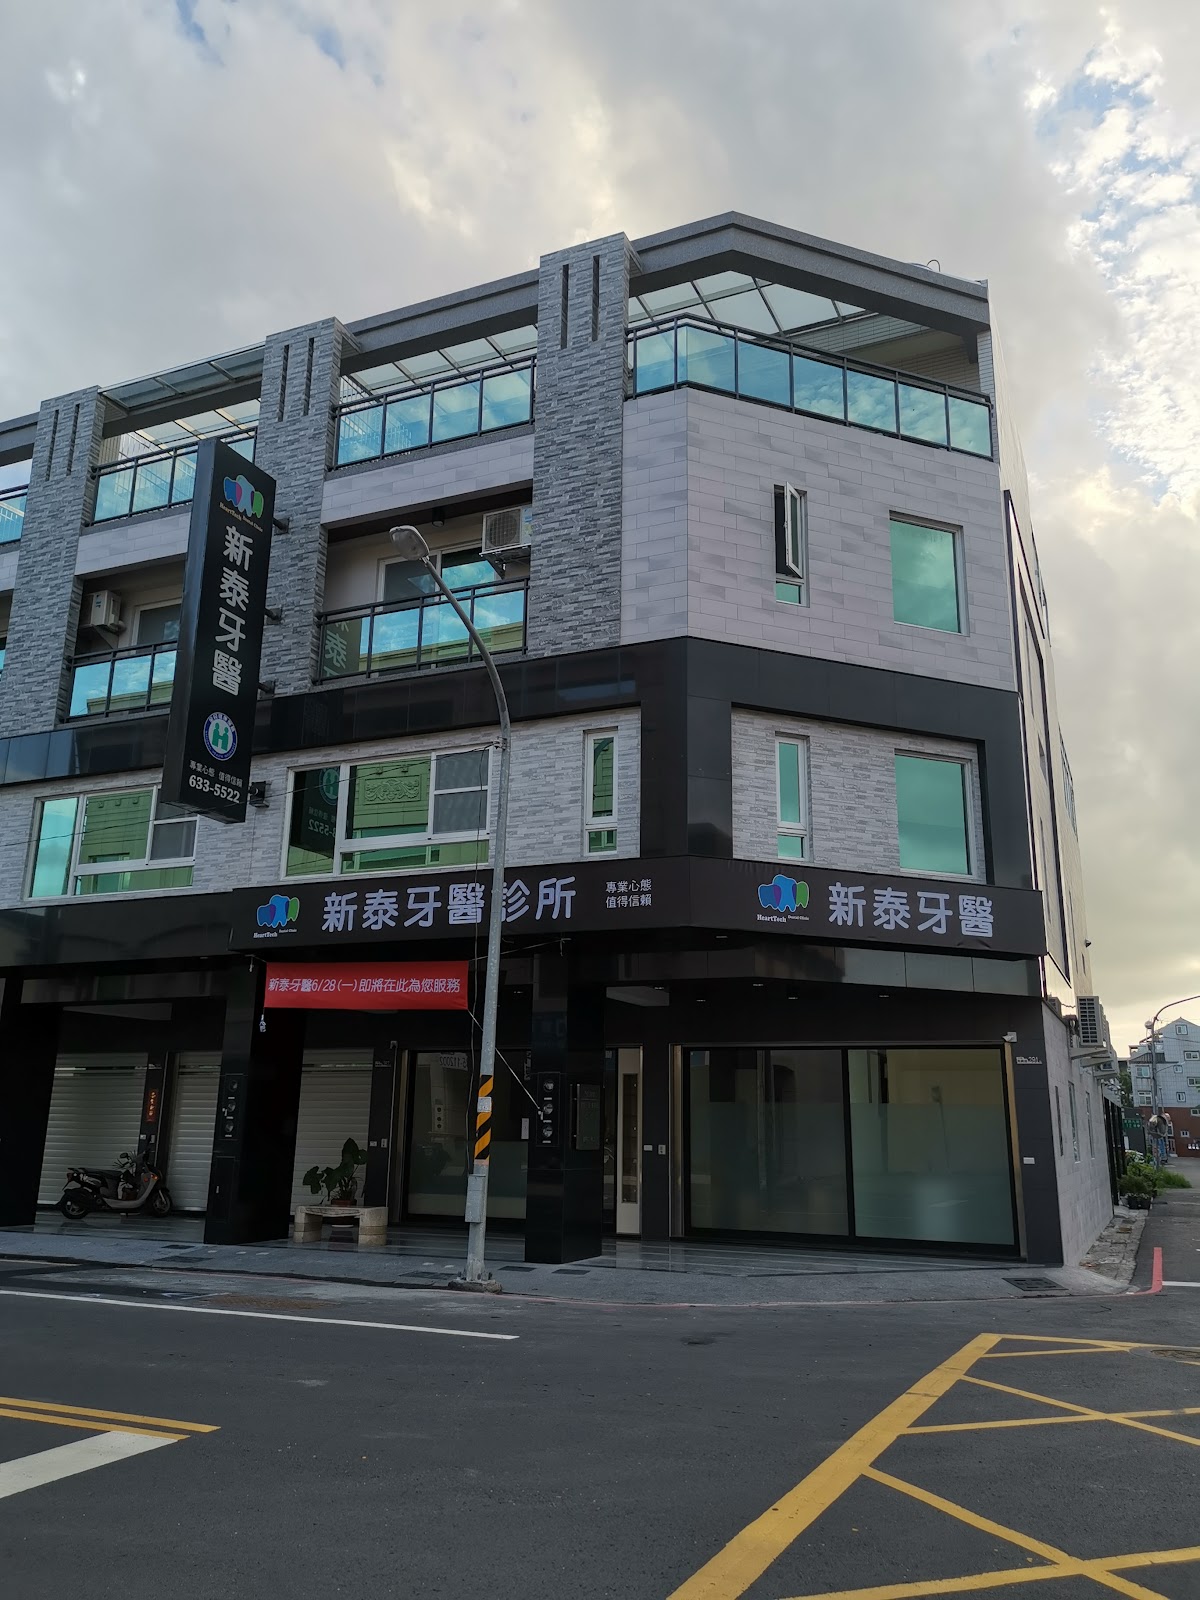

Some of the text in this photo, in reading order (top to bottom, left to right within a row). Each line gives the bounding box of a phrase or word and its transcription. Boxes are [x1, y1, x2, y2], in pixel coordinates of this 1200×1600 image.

[212, 525, 253, 697] 新泰牙醫
[189, 774, 241, 804] 633-5522
[605, 878, 652, 894] 專業心態
[605, 893, 652, 909] 值得信賴
[321, 876, 576, 932] 新泰牙醫診所
[757, 914, 787, 923] HeartTech
[828, 881, 994, 938] 新泰牙醫
